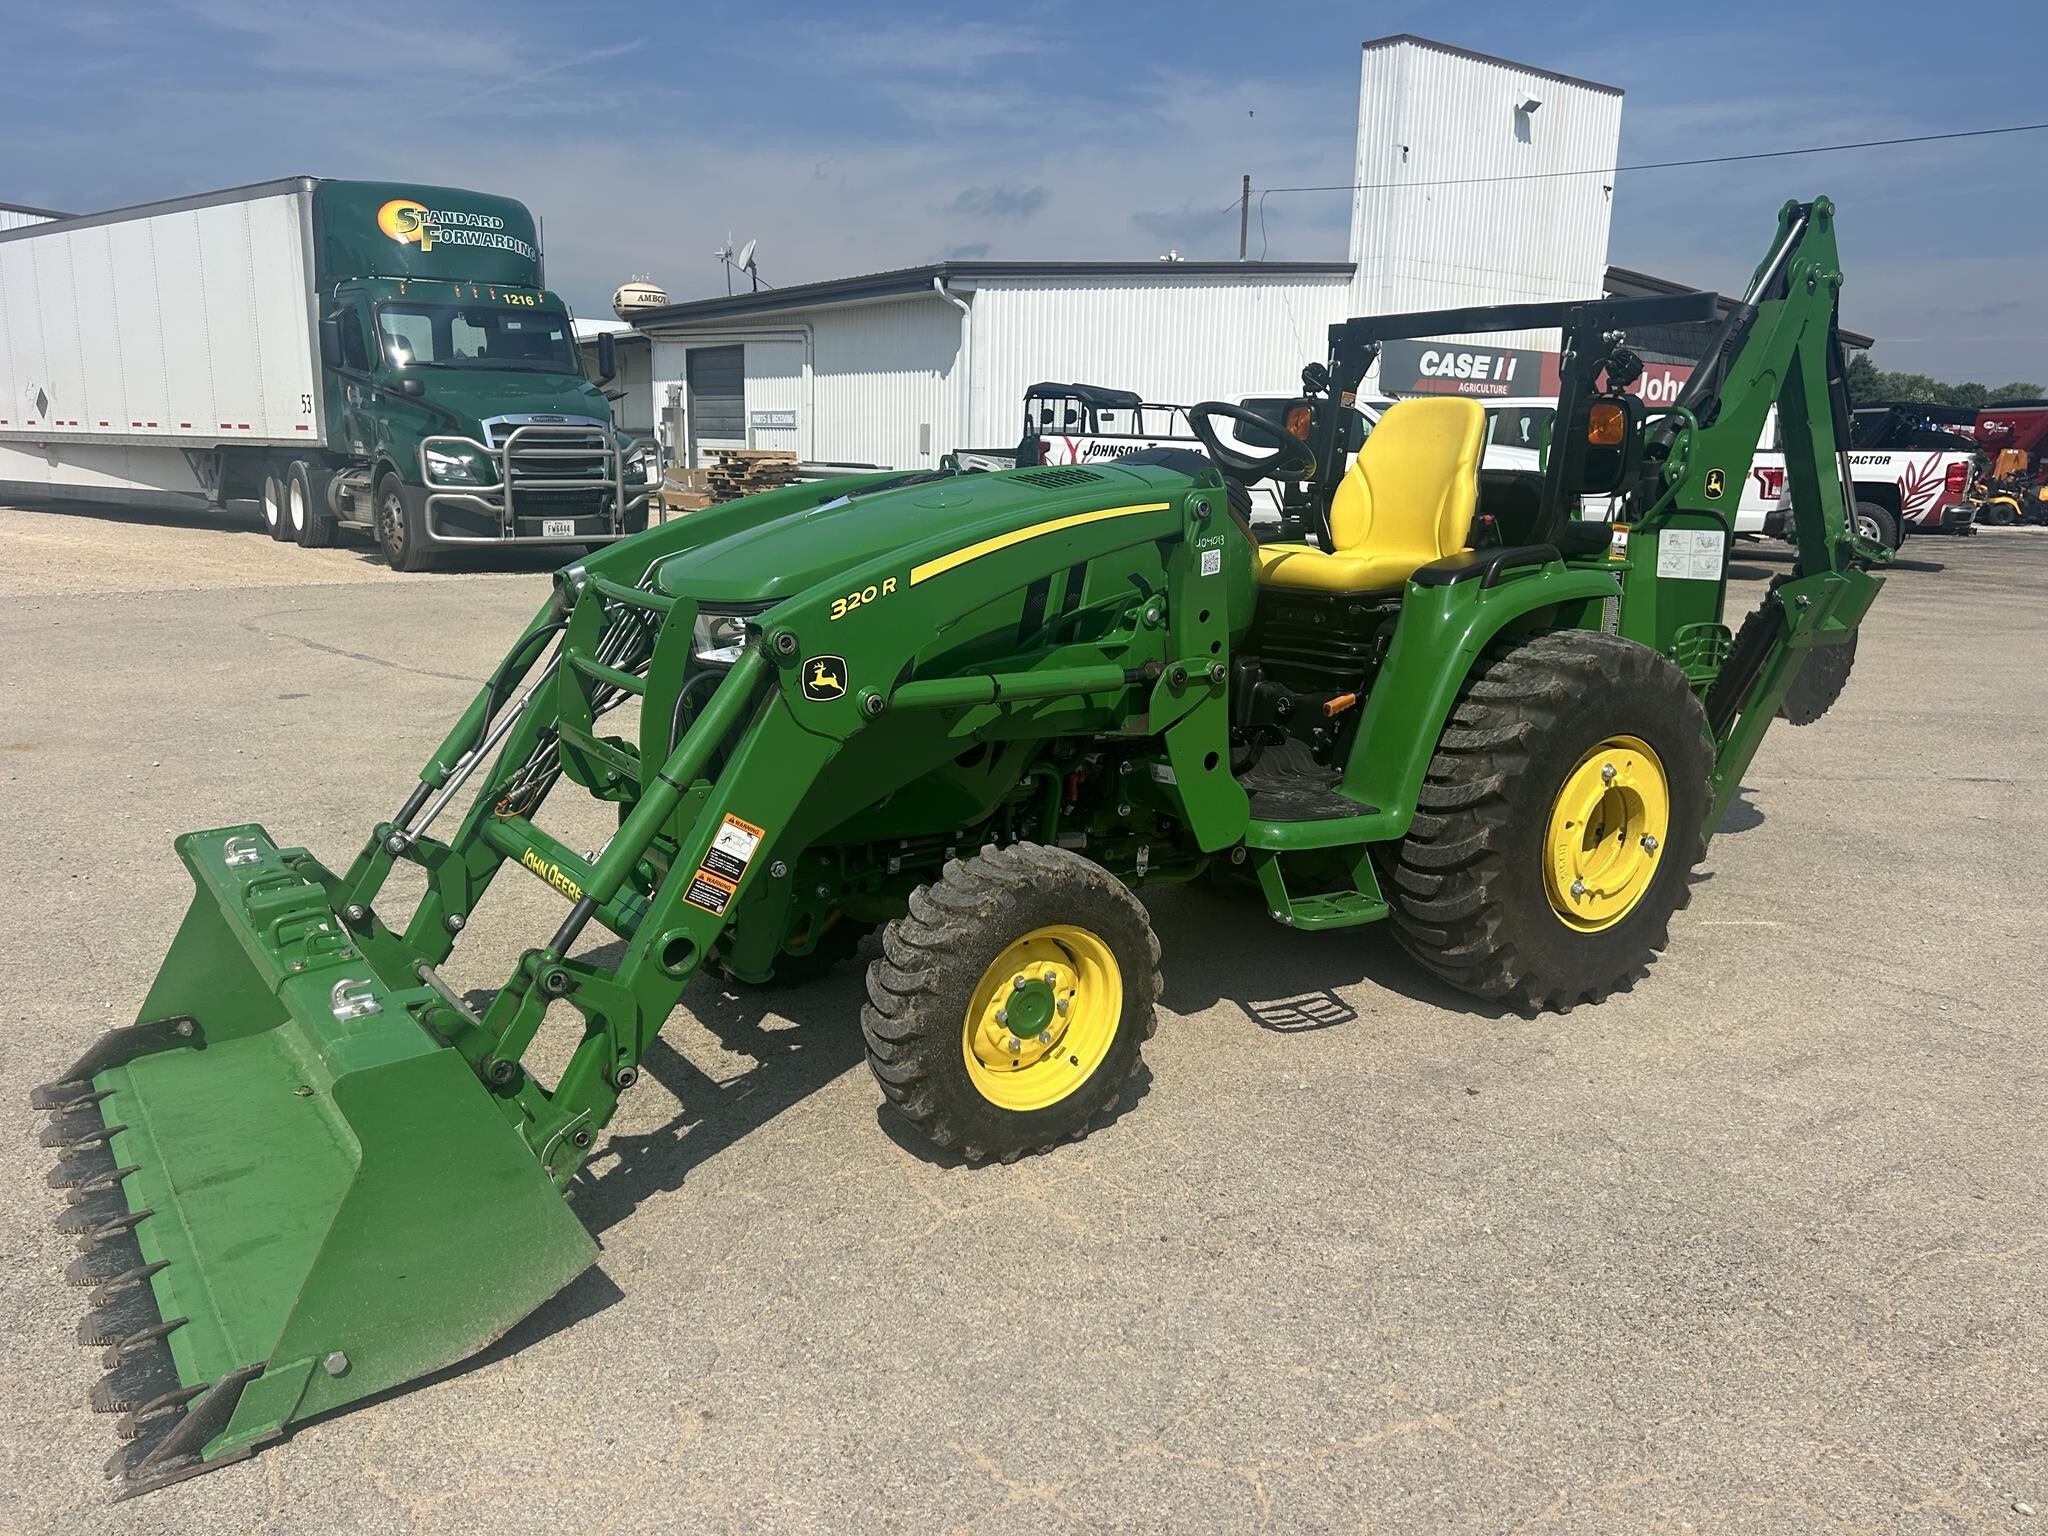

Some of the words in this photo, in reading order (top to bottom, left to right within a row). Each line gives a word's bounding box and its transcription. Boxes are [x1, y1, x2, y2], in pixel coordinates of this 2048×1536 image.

[396, 207, 504, 234] STANDARD
[420, 224, 537, 263] FORWARDING
[502, 293, 535, 306] 1216
[1419, 350, 1491, 379] CASE
[1458, 382, 1507, 395] AGRICULTURE
[830, 585, 878, 621] 320
[882, 576, 897, 597] R
[735, 819, 760, 836] WARNING
[520, 847, 549, 880] JOHN
[547, 864, 583, 903] DEERE
[706, 876, 732, 892] WARNING
